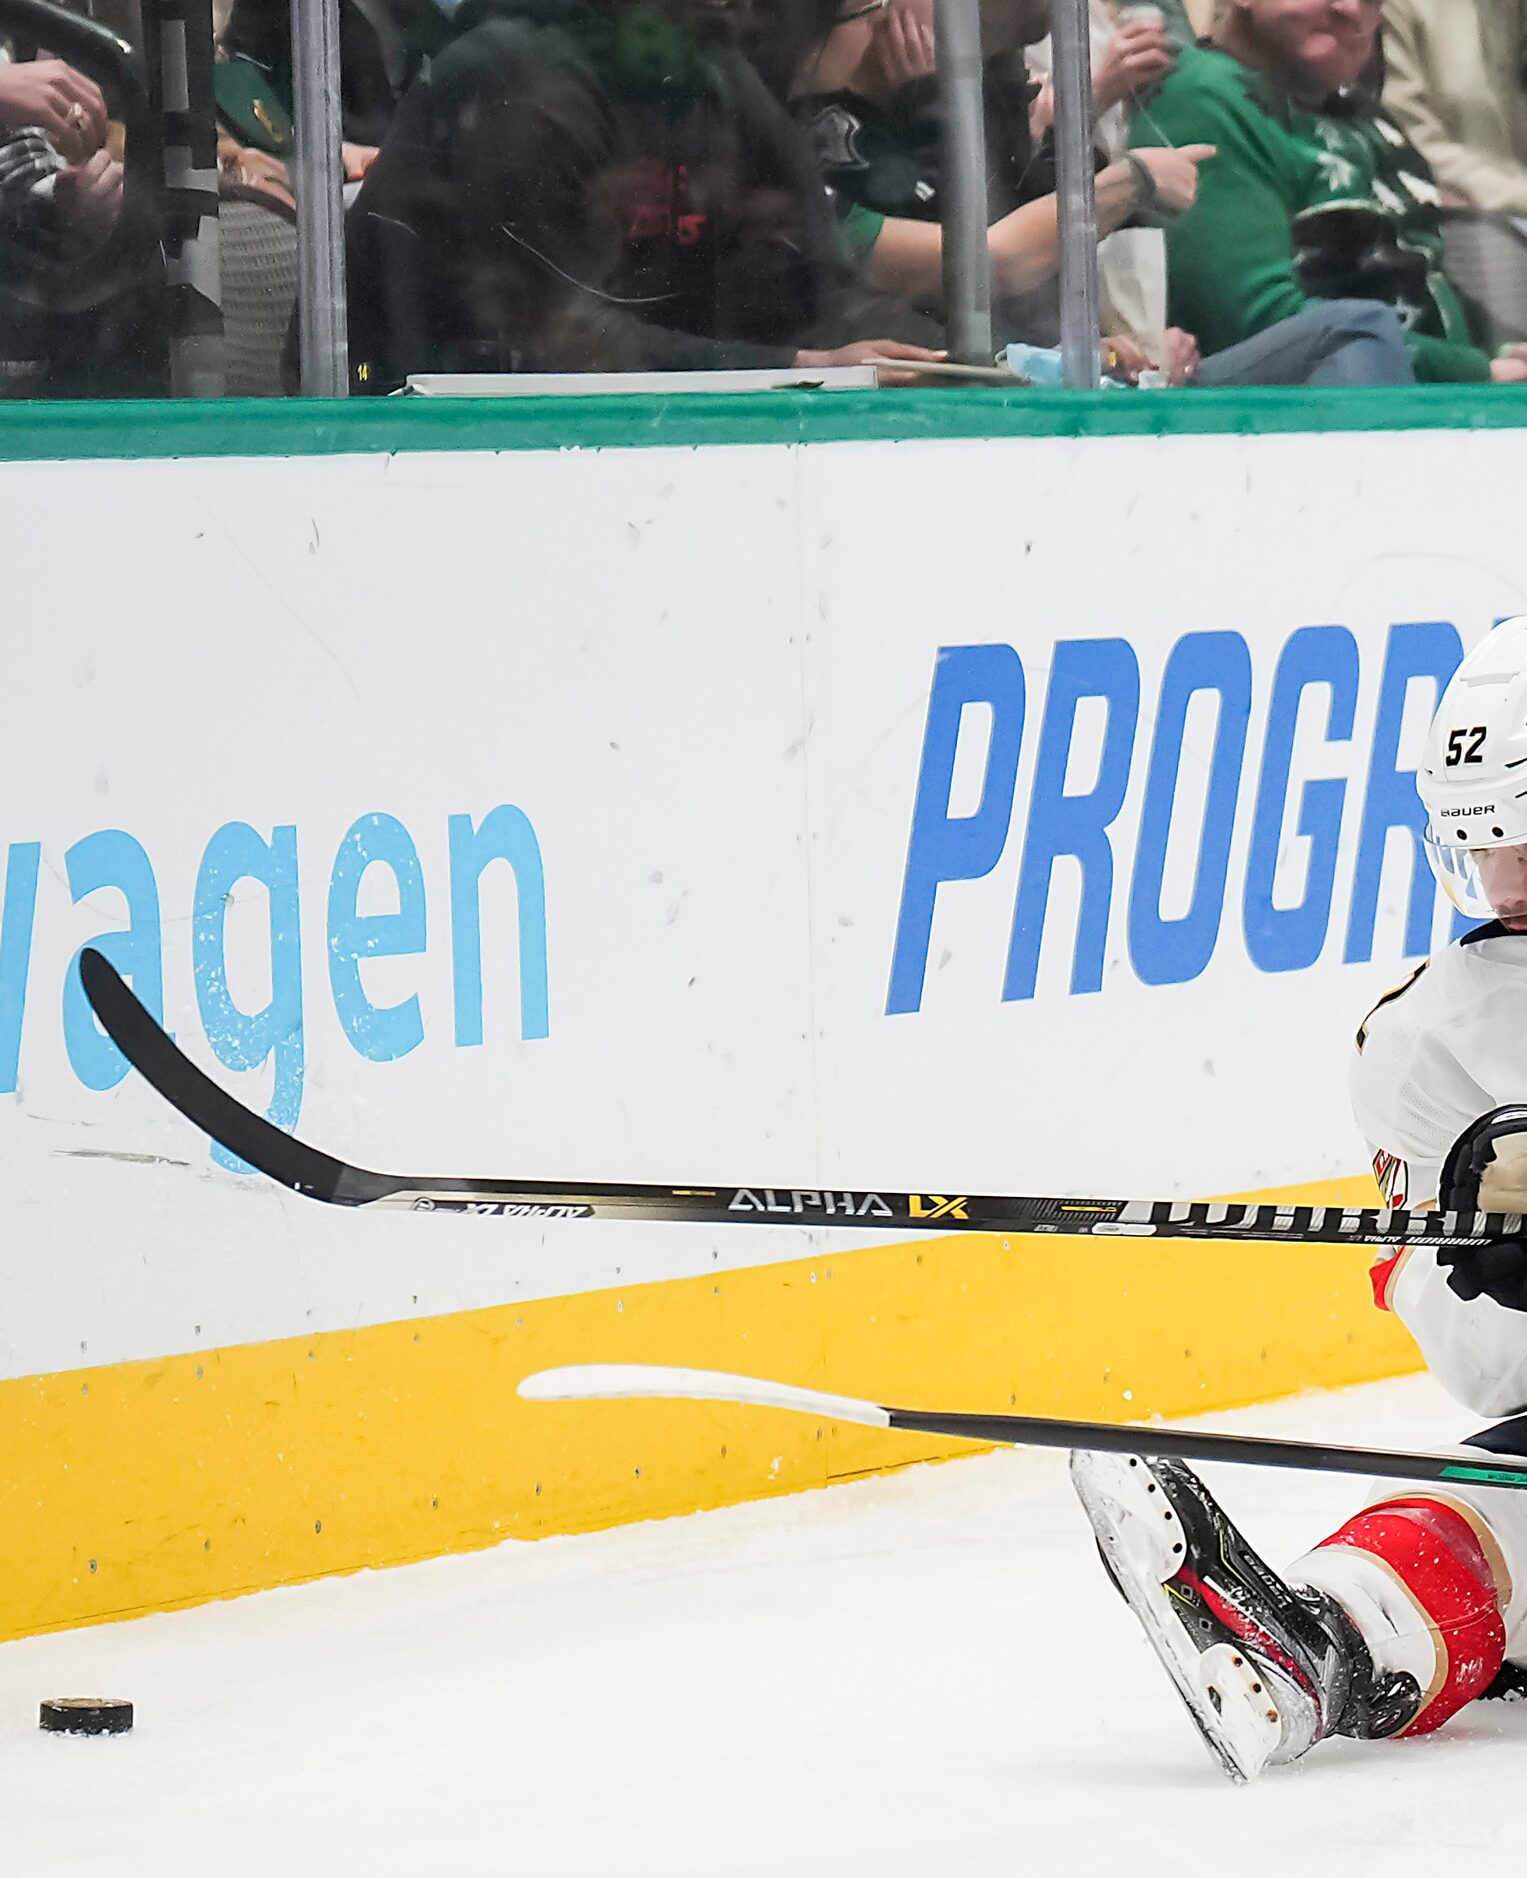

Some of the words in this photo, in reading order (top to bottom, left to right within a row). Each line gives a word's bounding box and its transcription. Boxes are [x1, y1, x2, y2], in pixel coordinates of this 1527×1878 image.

[1445, 726, 1488, 767] 52
[1440, 803, 1496, 818] BAUER
[0, 803, 550, 1175] agen
[727, 1188, 893, 1218] ALPHA
[908, 1195, 969, 1220] LX
